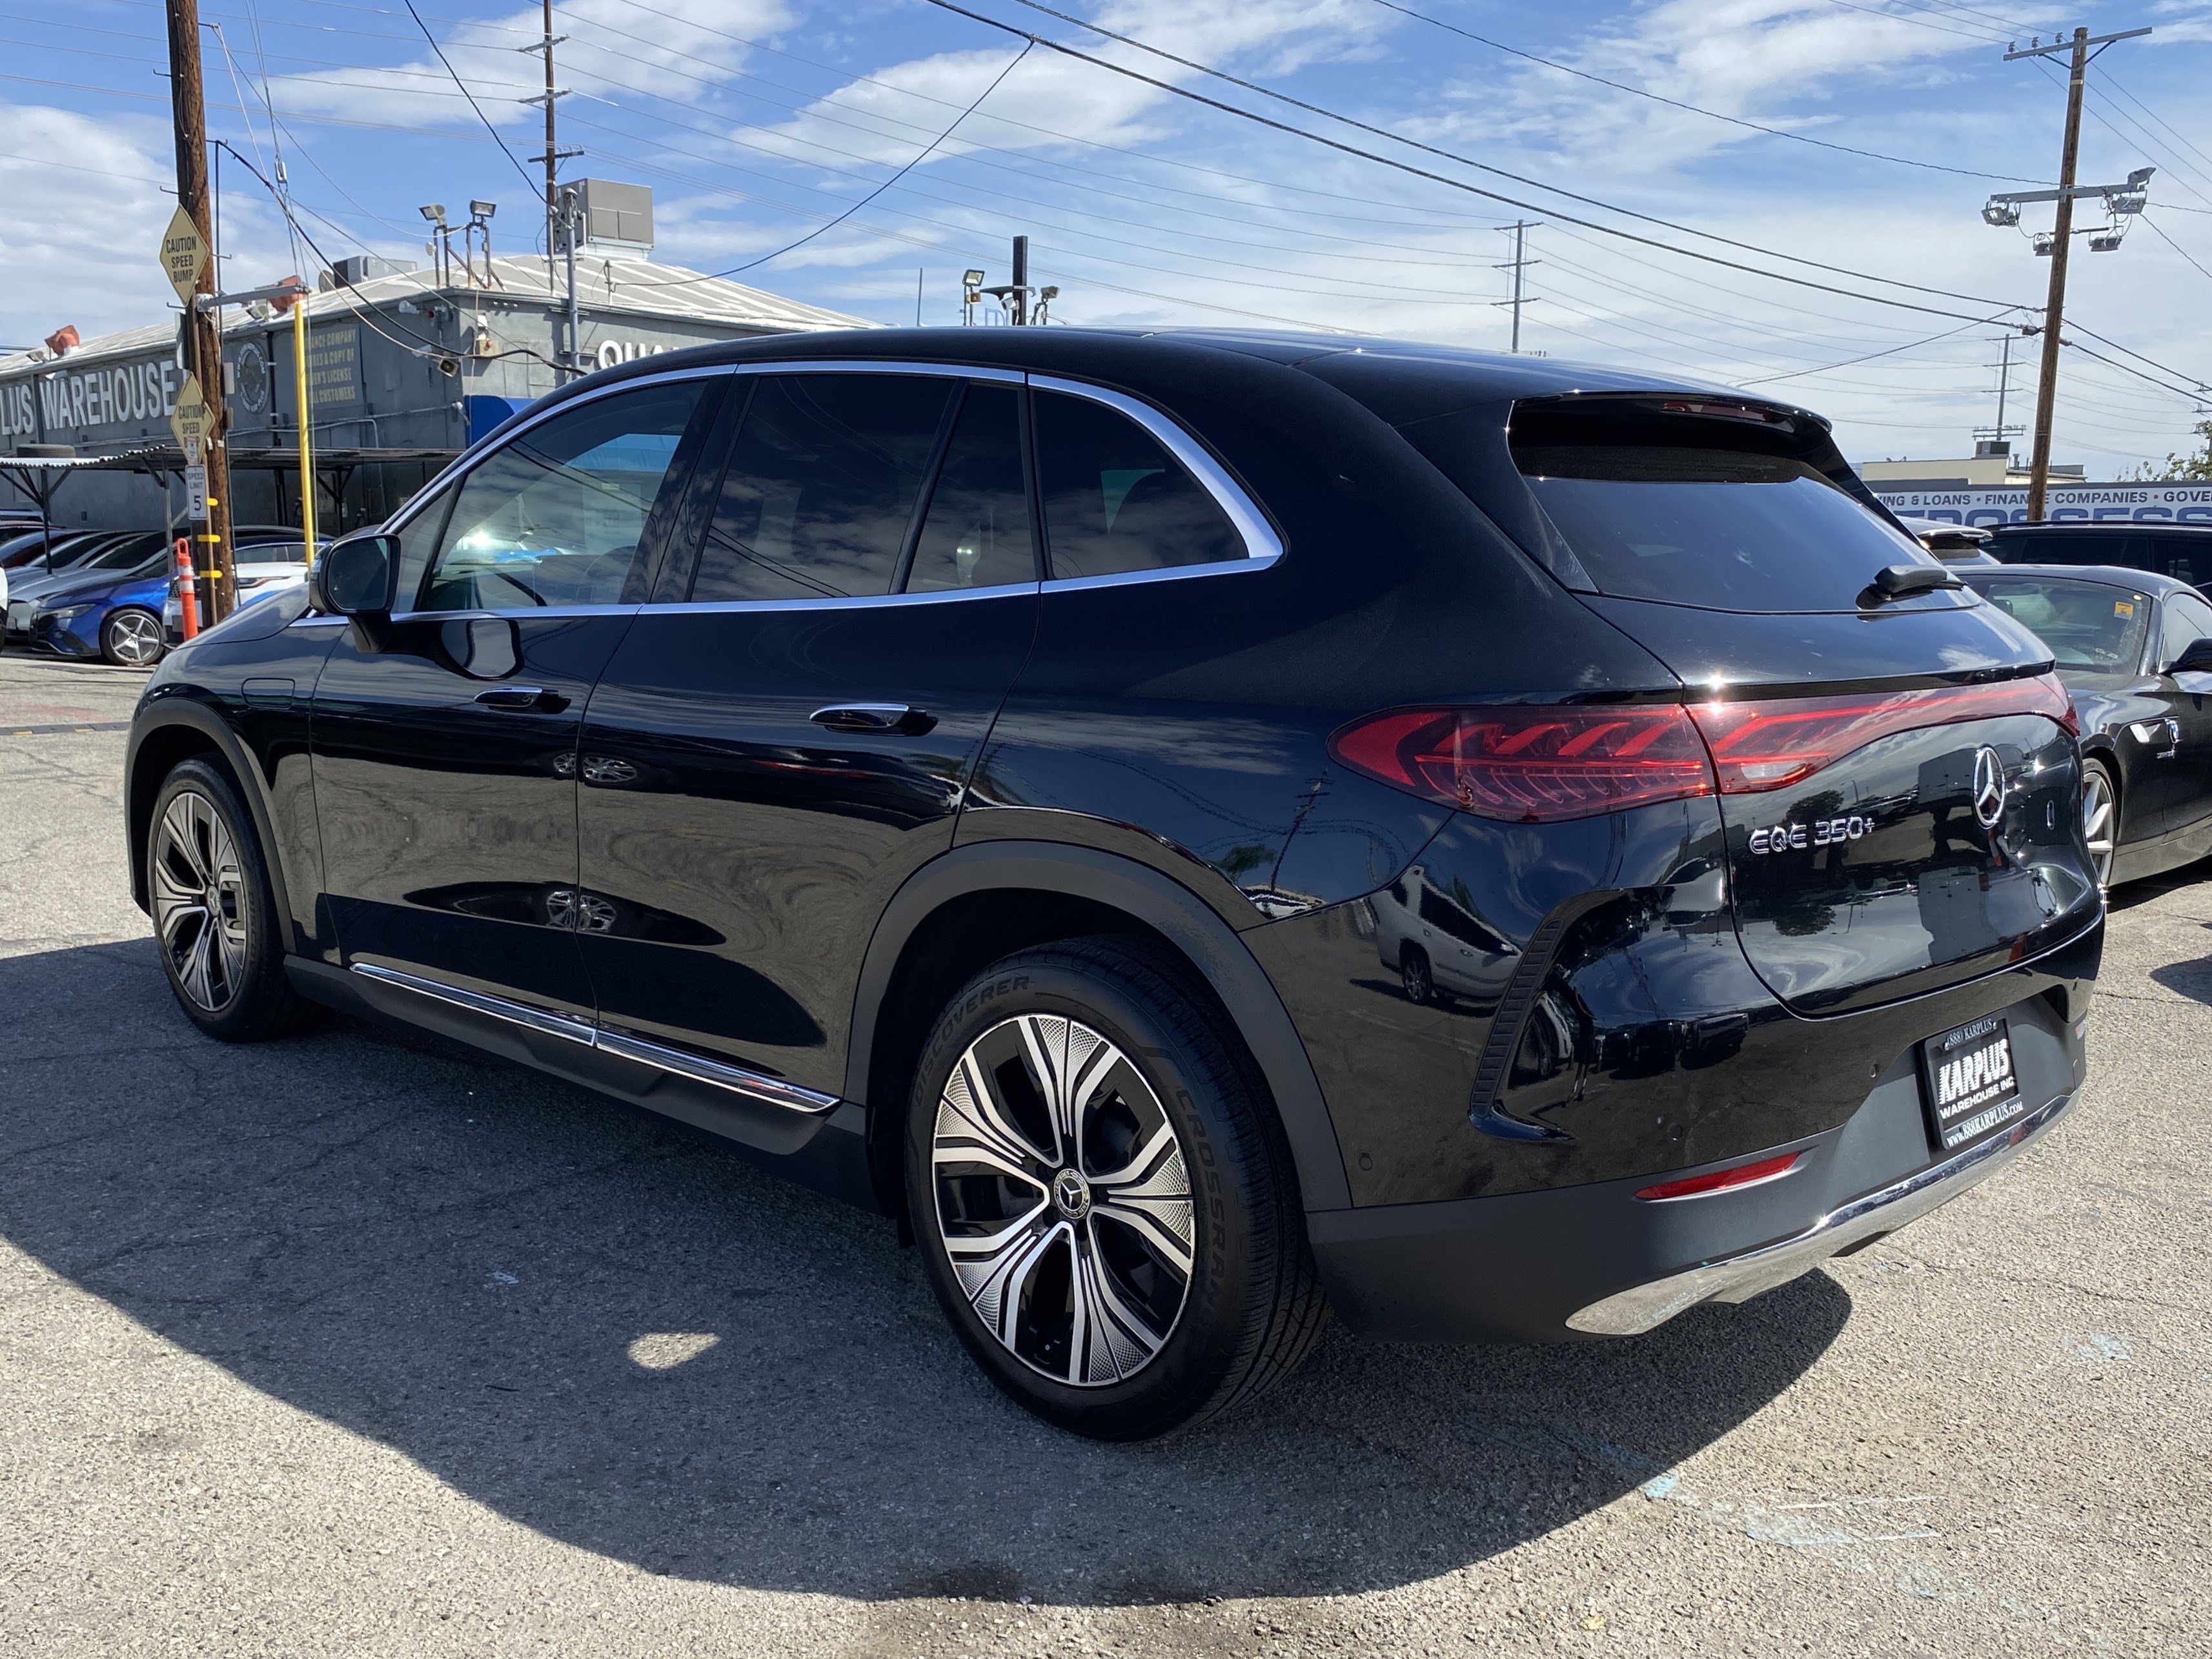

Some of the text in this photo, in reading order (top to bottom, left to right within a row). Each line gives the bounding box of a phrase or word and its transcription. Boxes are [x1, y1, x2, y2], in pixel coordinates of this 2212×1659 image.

[166, 236, 196, 254] CAUTION
[171, 254, 194, 269] SPEED
[173, 269, 194, 283] BUMP
[327, 329, 356, 347] COMPANY
[329, 350, 346, 365] COPY
[347, 348, 354, 362] OF
[327, 367, 352, 384] LICENSE
[39, 360, 176, 431] WAREHOUSE
[319, 385, 356, 403] CUSTOMERS
[178, 404, 203, 420] CAUTION
[182, 422, 200, 434] SPEED
[184, 436, 200, 449] BP
[189, 482, 203, 490] LIMIT
[194, 494, 202, 511] 5
[1879, 491, 2212, 506] ING & LOANS FINANE COMPANIES GOVE
[1749, 815, 1875, 855] EQE 350+
[1963, 1018, 1992, 1041] KARPLUS
[1938, 1038, 2009, 1105] KARPLUS
[1939, 1084, 2000, 1120] WAREHOUSE
